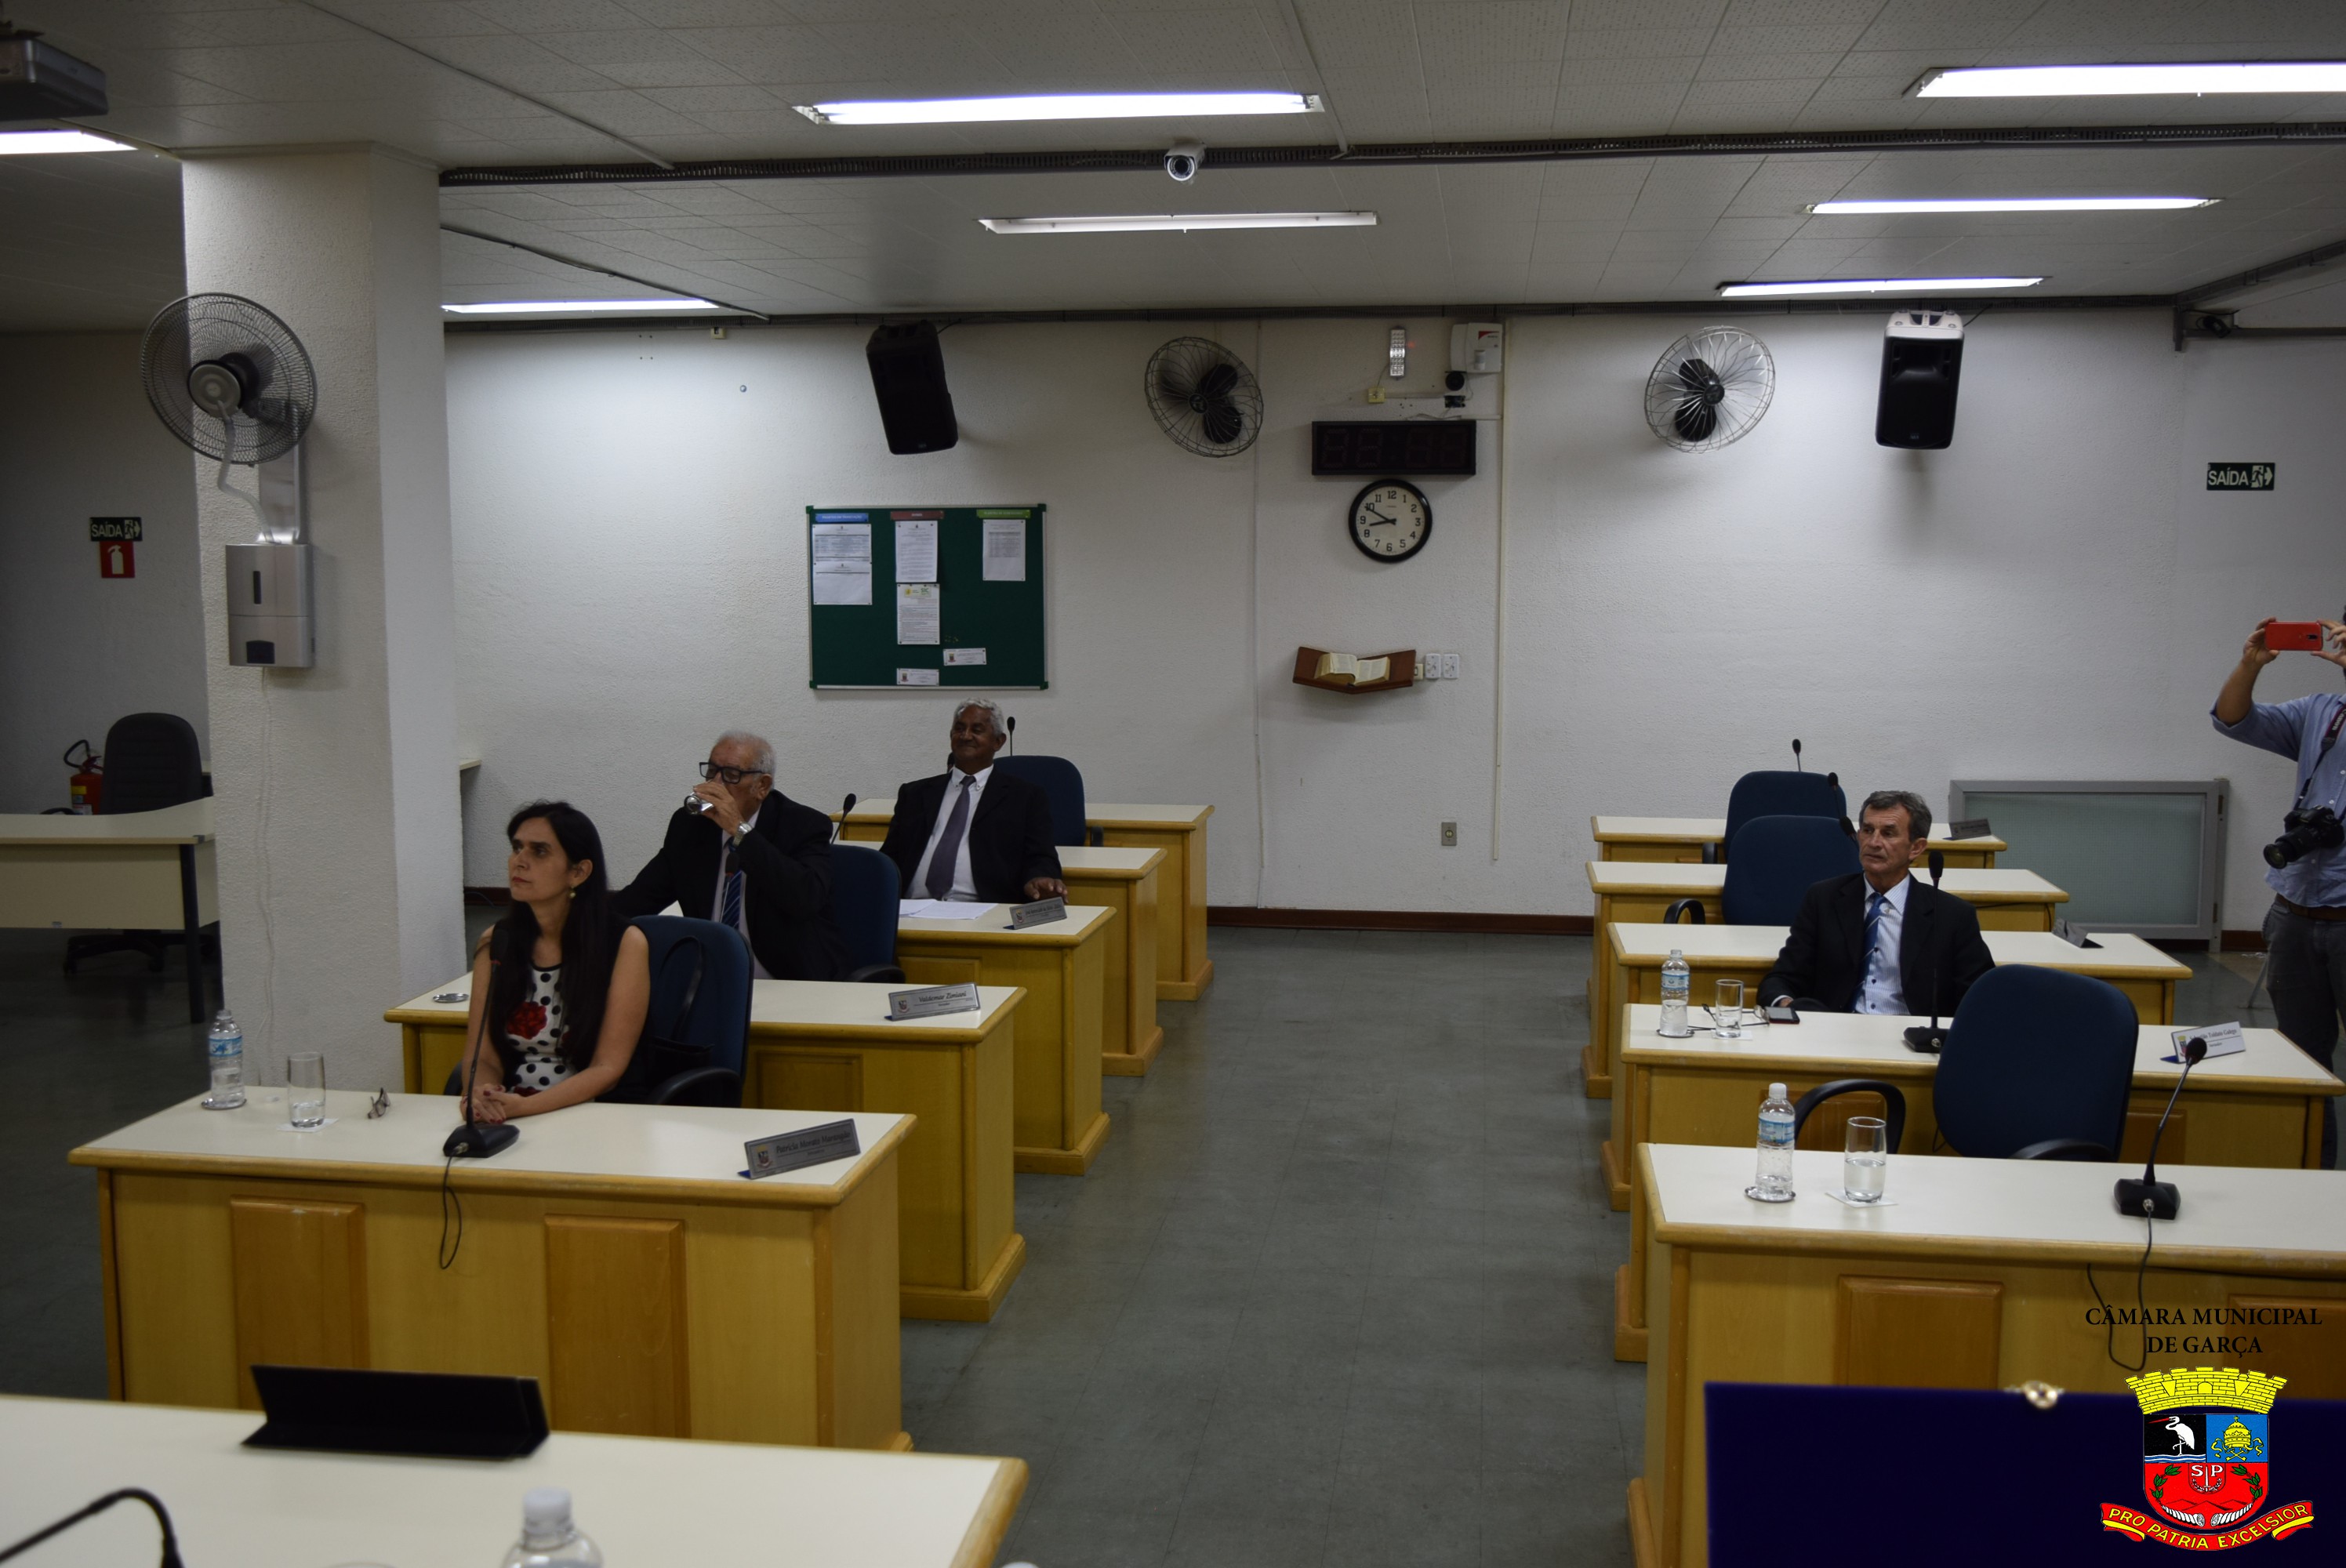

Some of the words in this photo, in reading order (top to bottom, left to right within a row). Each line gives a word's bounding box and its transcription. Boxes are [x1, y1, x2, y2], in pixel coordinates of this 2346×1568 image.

[2208, 466, 2249, 485] SAÍDA
[1375, 494, 1382, 503] 11
[1387, 490, 1396, 499] 12
[1365, 503, 1375, 511] 10
[1411, 504, 1417, 513] 2
[1360, 516, 1366, 524] 9
[1414, 517, 1421, 526] 3
[92, 521, 123, 538] SAÍDA
[1364, 529, 1370, 538] 8
[1410, 531, 1416, 539] 4
[1375, 539, 1380, 548] 7
[1386, 543, 1393, 551] 6
[1400, 539, 1406, 548] 5
